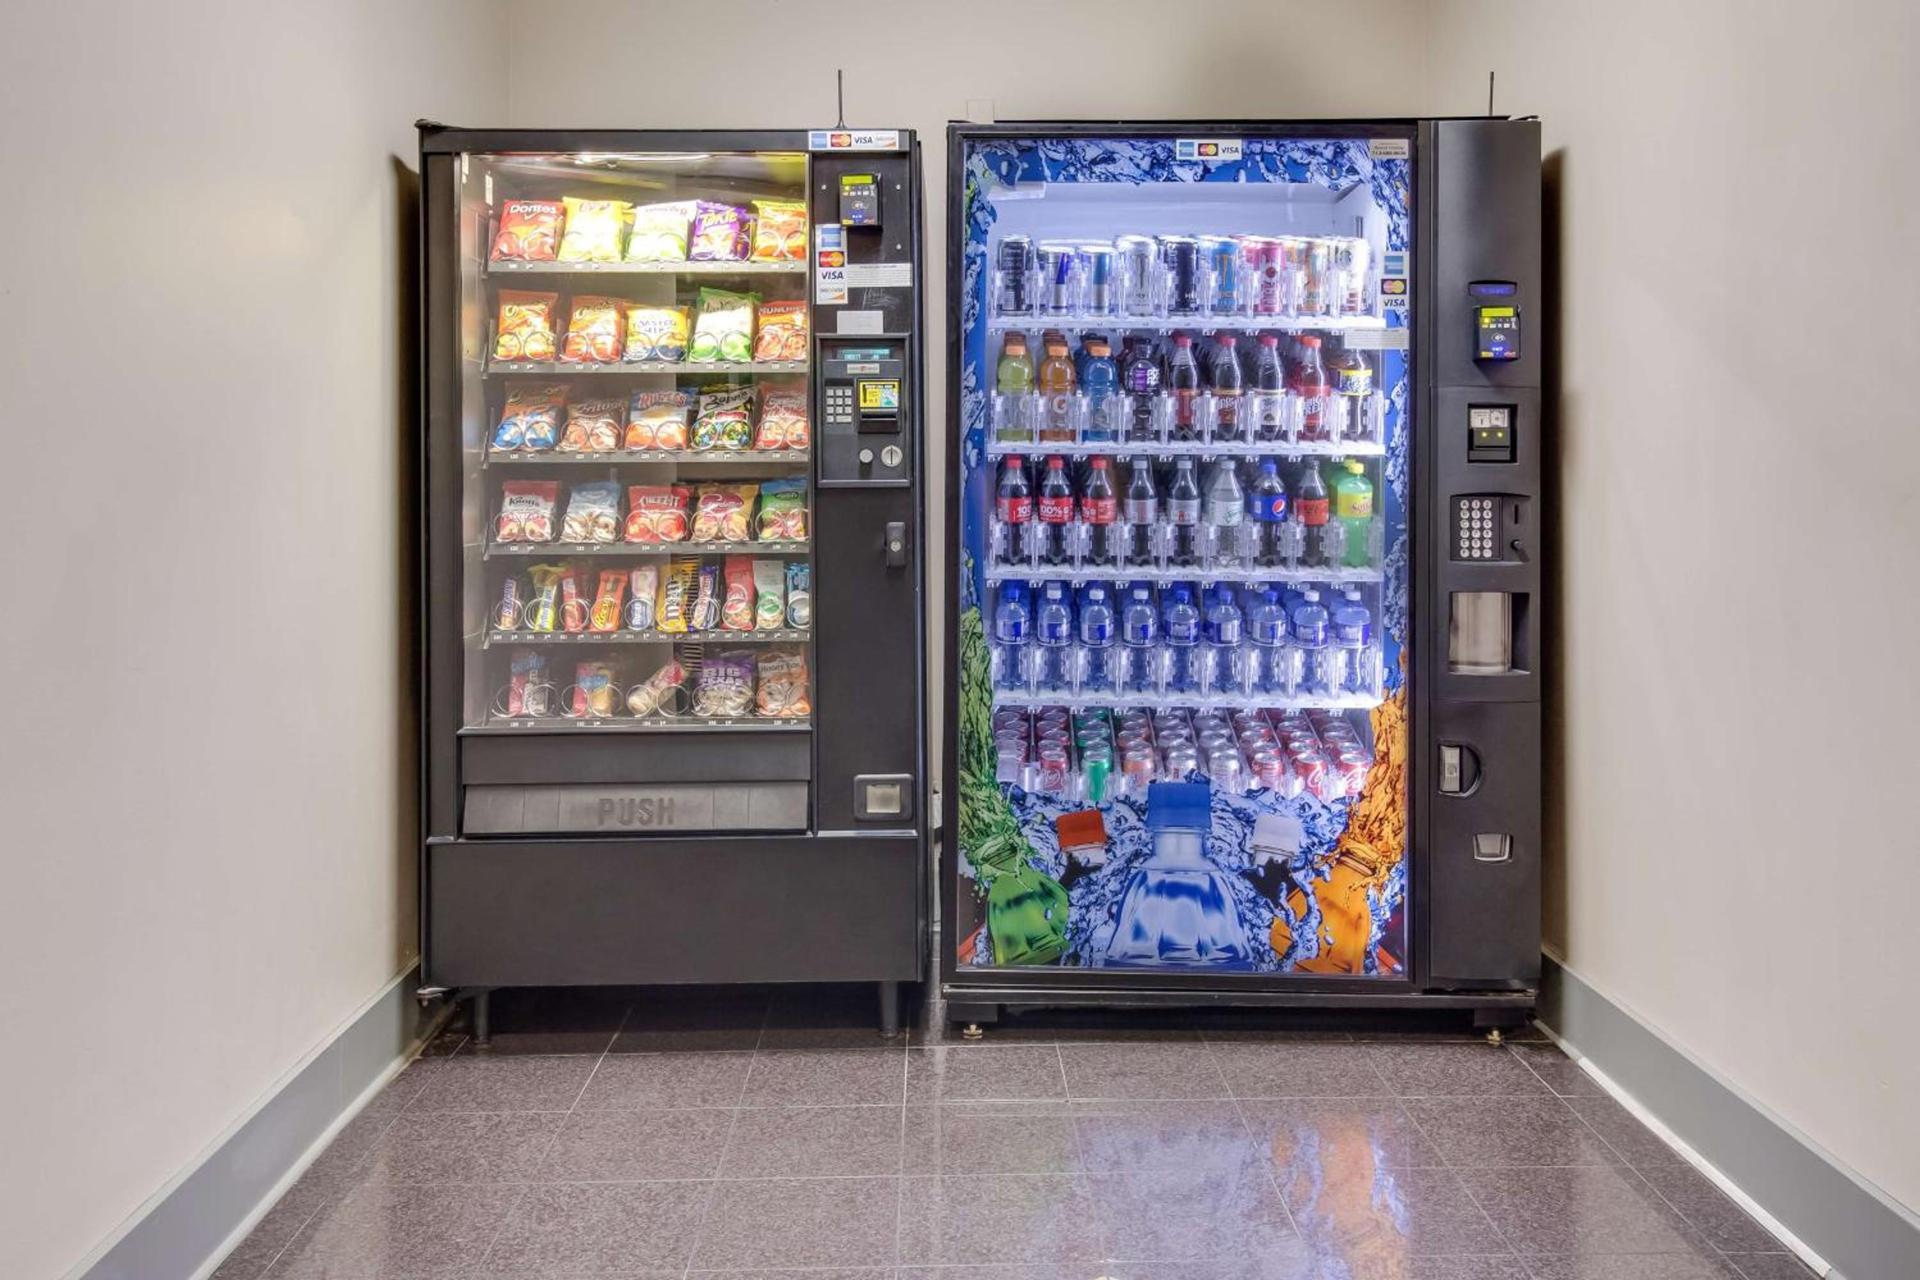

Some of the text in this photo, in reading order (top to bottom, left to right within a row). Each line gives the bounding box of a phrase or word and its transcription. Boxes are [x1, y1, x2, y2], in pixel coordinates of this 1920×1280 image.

[854, 136, 873, 144] VISA
[1221, 146, 1239, 154] VISA
[510, 204, 556, 214] Doritos
[821, 271, 844, 280] VISA
[1384, 299, 1405, 307] VISA
[702, 667, 741, 677] BIG
[598, 798, 674, 826] PUSH
